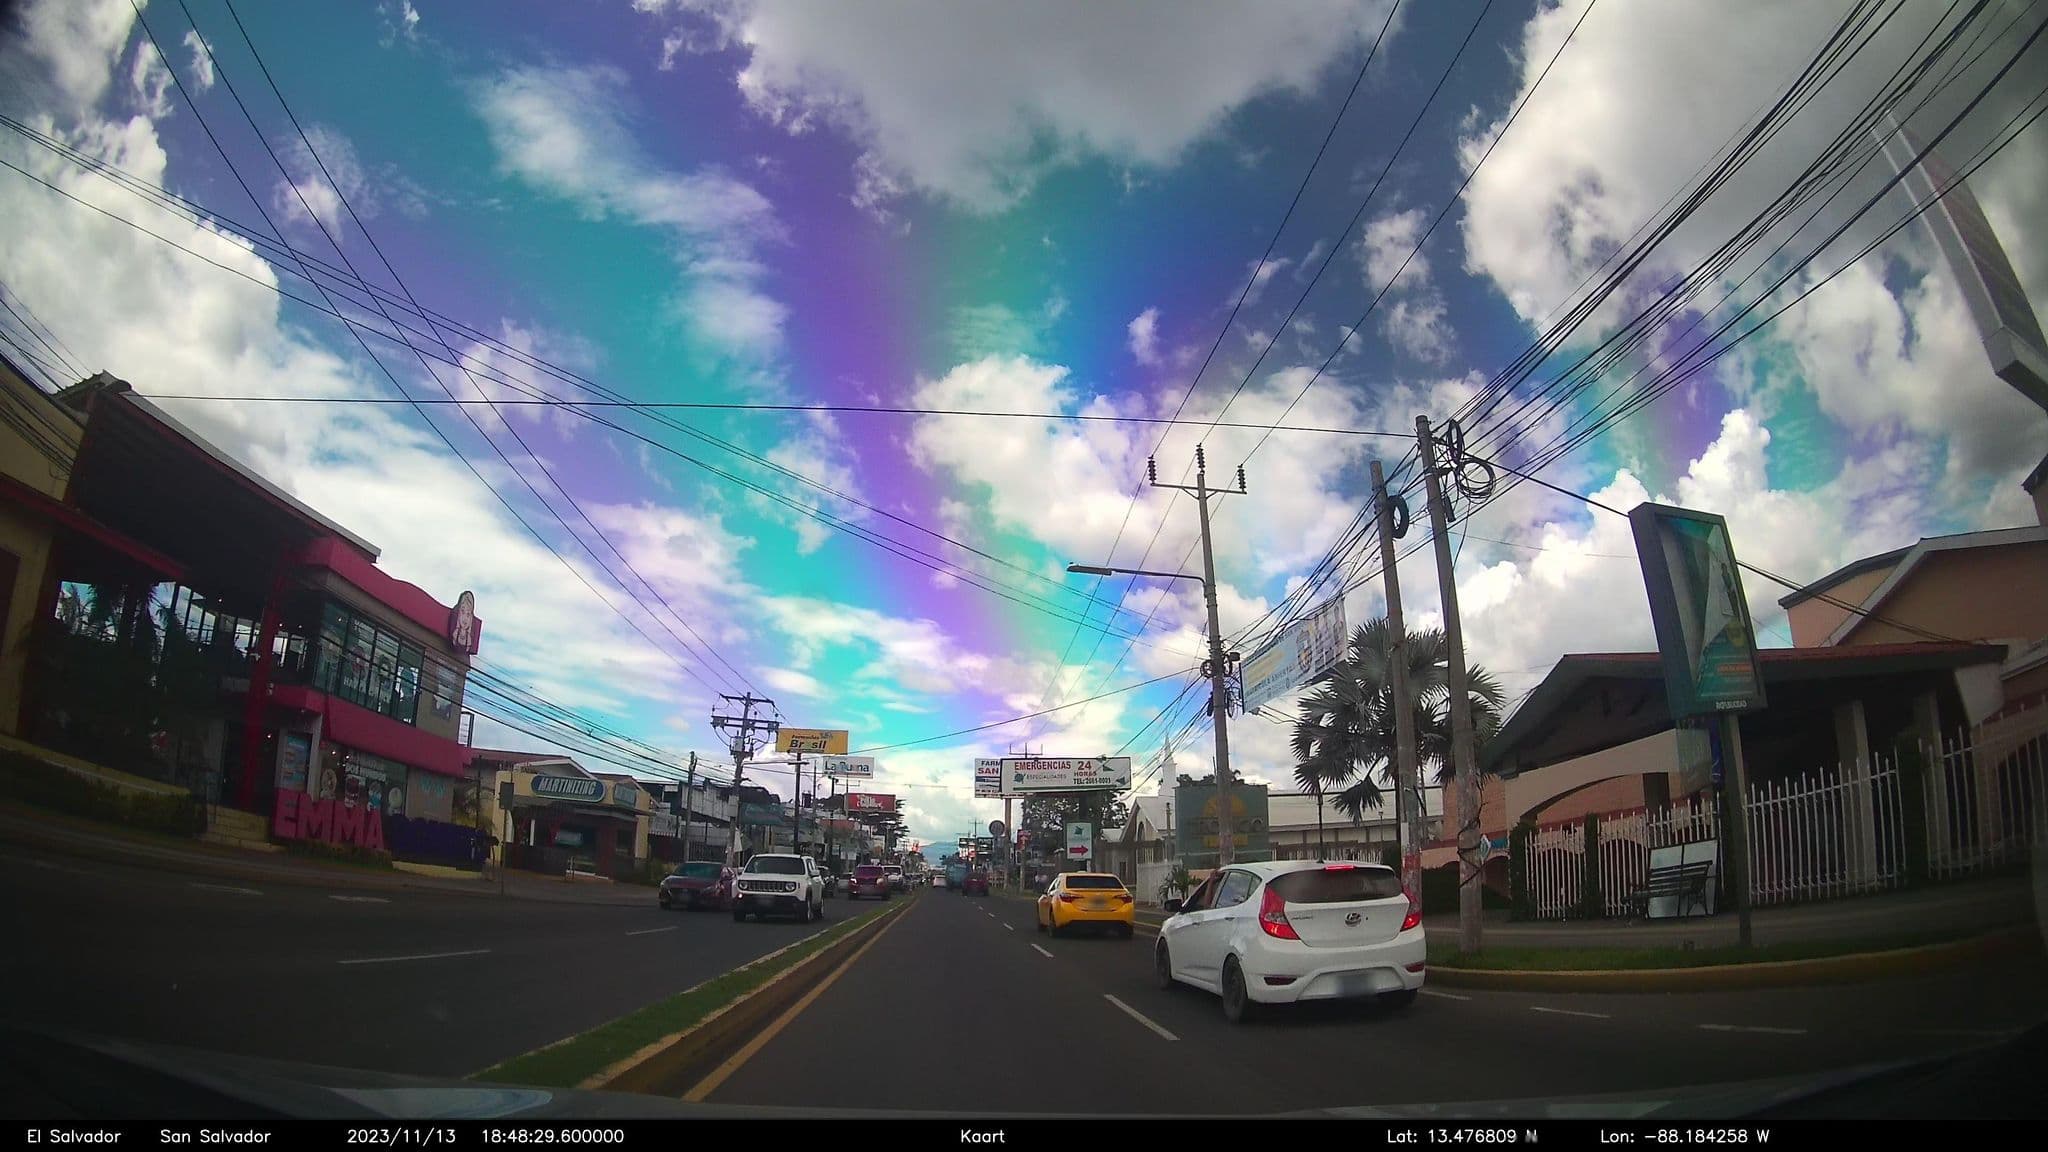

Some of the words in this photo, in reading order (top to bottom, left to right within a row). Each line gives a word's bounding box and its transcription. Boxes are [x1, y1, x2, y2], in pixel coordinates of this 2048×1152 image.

[824, 760, 836, 771] La
[978, 767, 999, 775] SAN
[1014, 760, 1071, 771] EMERGENCIAS
[1077, 760, 1092, 771] 24
[537, 777, 597, 796] MARTINIZING
[274, 788, 385, 851] EMMA
